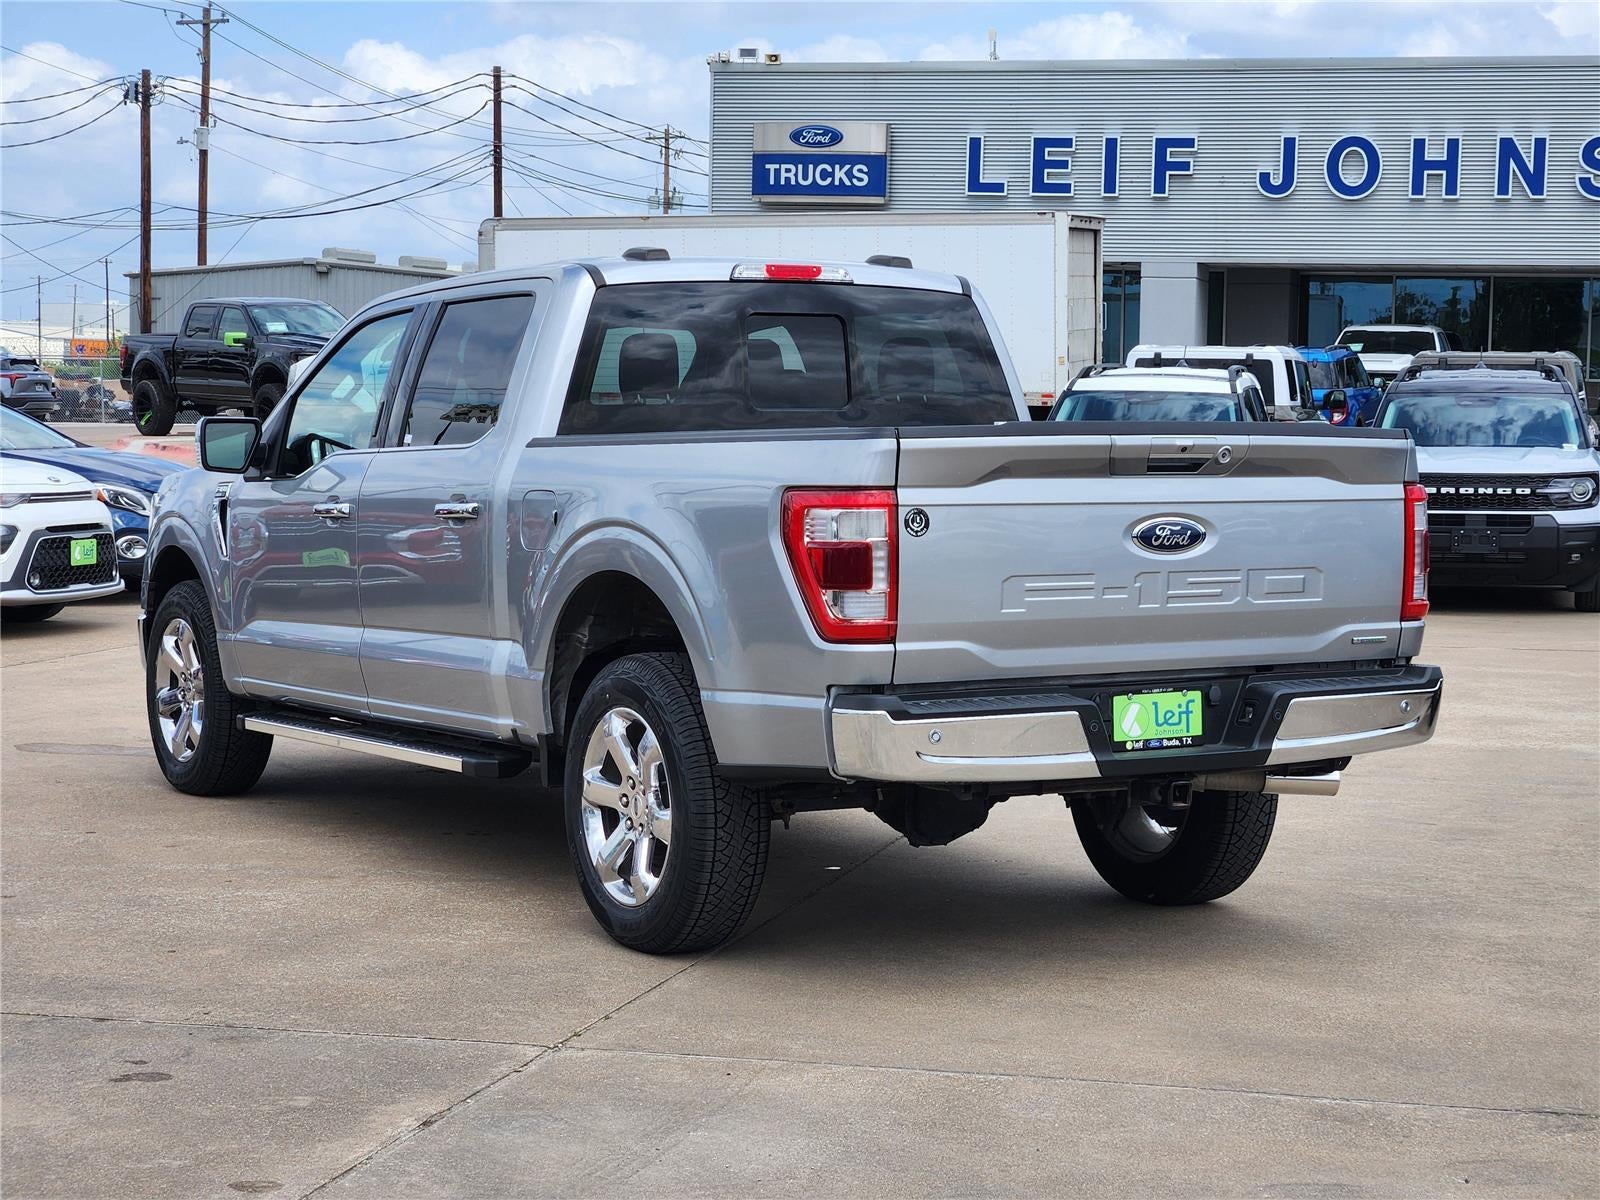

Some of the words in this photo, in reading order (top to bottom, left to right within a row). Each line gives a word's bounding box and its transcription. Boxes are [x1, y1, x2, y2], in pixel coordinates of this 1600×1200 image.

[800, 129, 832, 144] Ford
[765, 163, 870, 187] TRUCKS
[966, 135, 1199, 197] LEIF
[1151, 524, 1192, 546] Ford
[1000, 566, 1325, 613] F-150
[1152, 698, 1195, 733] leif
[1155, 728, 1184, 736] Johnson
[1163, 738, 1181, 747] Buda,
[1182, 737, 1193, 745] TX
